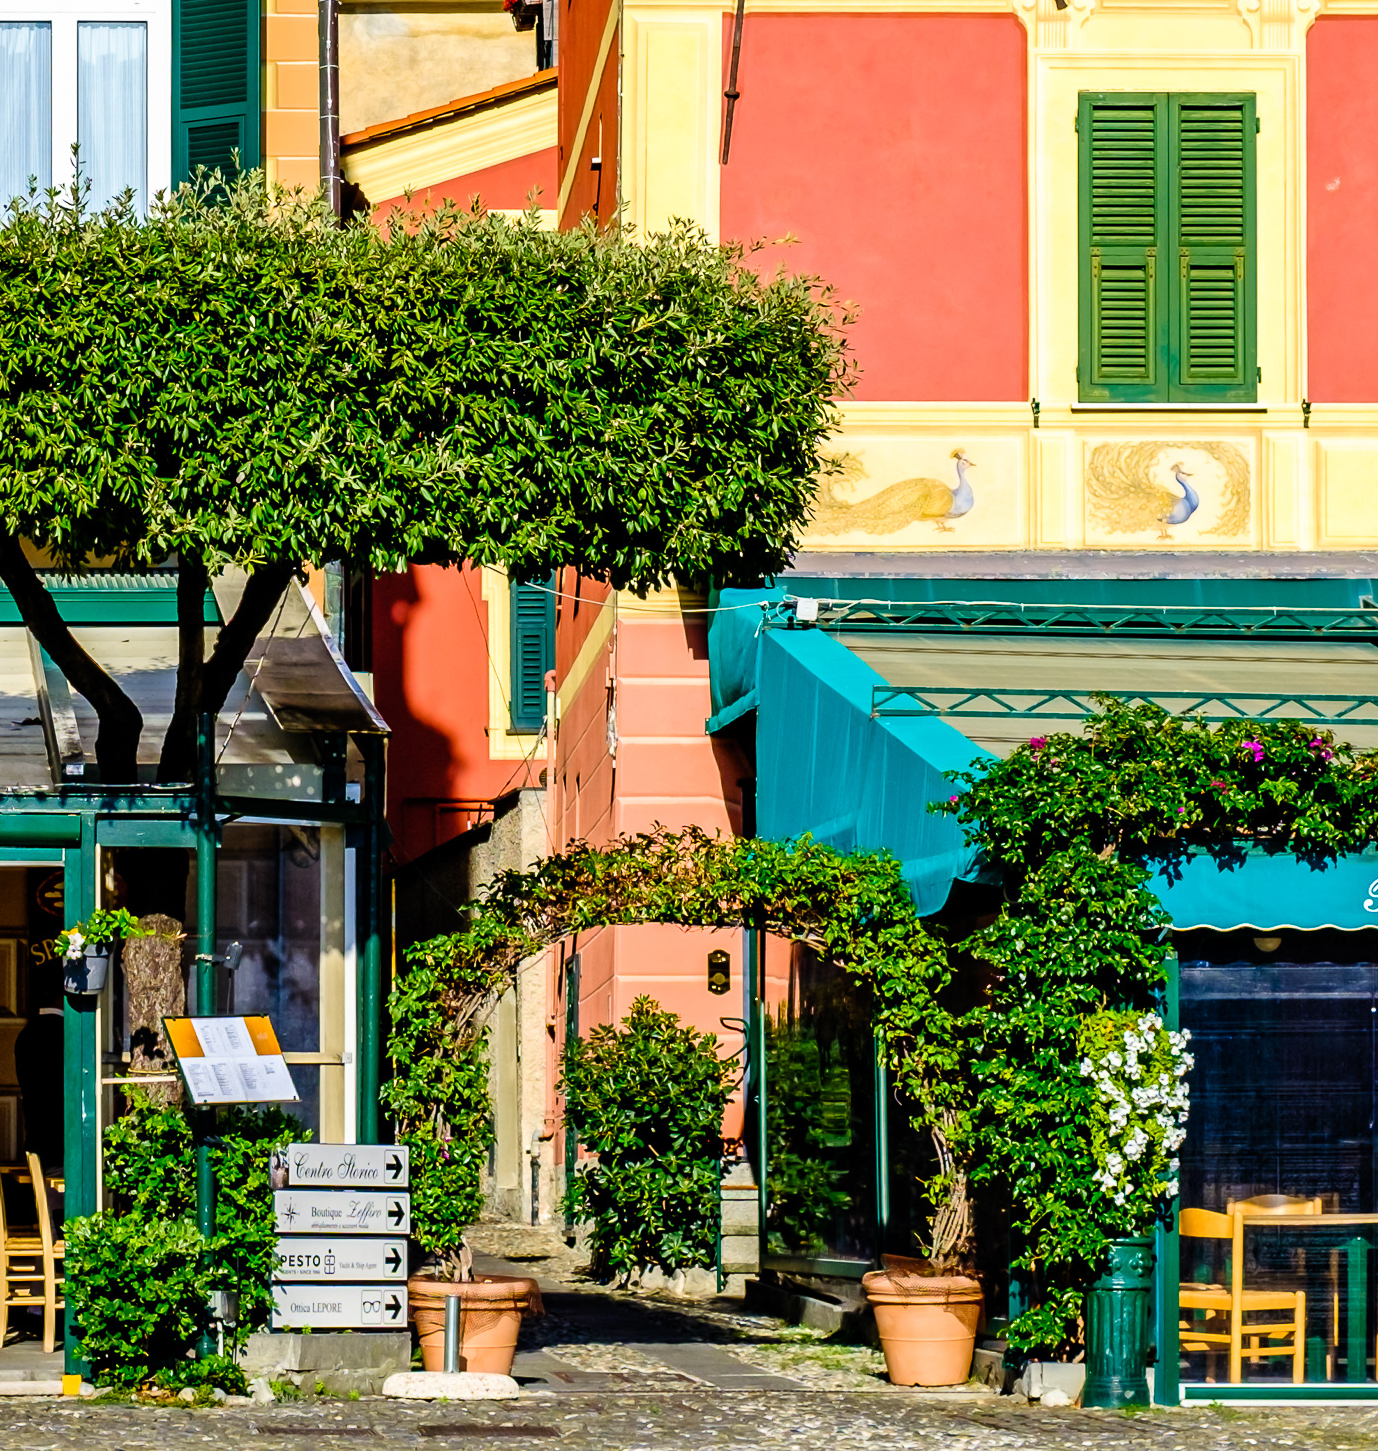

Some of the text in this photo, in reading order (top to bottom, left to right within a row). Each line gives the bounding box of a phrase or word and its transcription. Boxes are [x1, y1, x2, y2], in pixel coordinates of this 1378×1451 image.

[294, 1151, 379, 1180] Centro Storico
[311, 1200, 382, 1223] Boutique Zeffiro
[280, 1254, 321, 1267] PESTO
[290, 1302, 342, 1314] Ottica LEPORE
